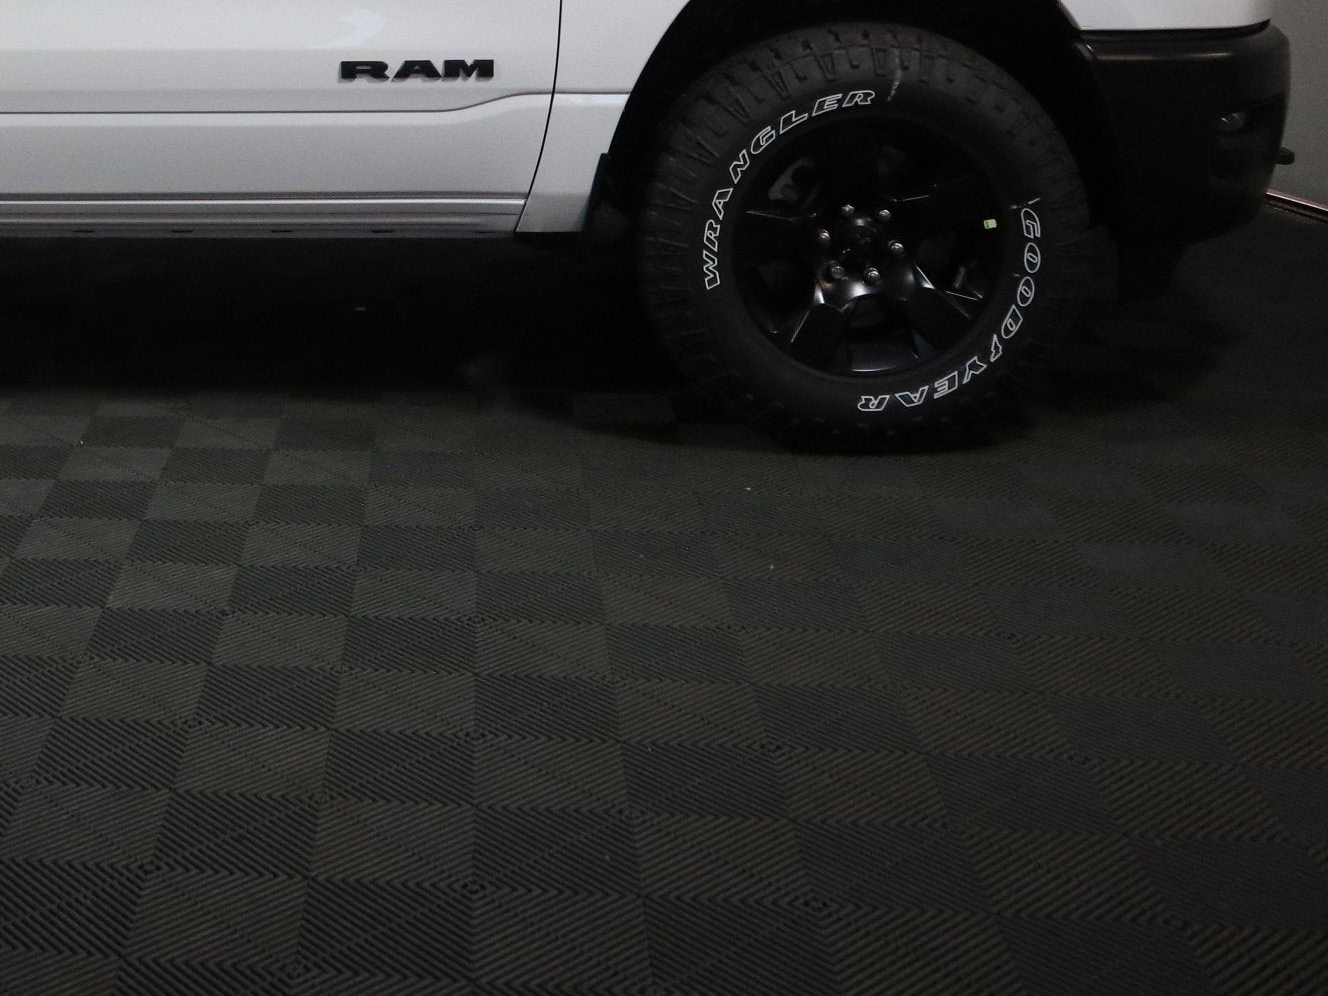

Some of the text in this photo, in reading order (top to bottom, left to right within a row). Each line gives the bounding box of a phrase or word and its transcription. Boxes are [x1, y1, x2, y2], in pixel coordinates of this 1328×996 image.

[340, 59, 494, 80] RAM
[702, 90, 875, 290] WRANGLER
[857, 208, 1041, 411] GOODYEAR
